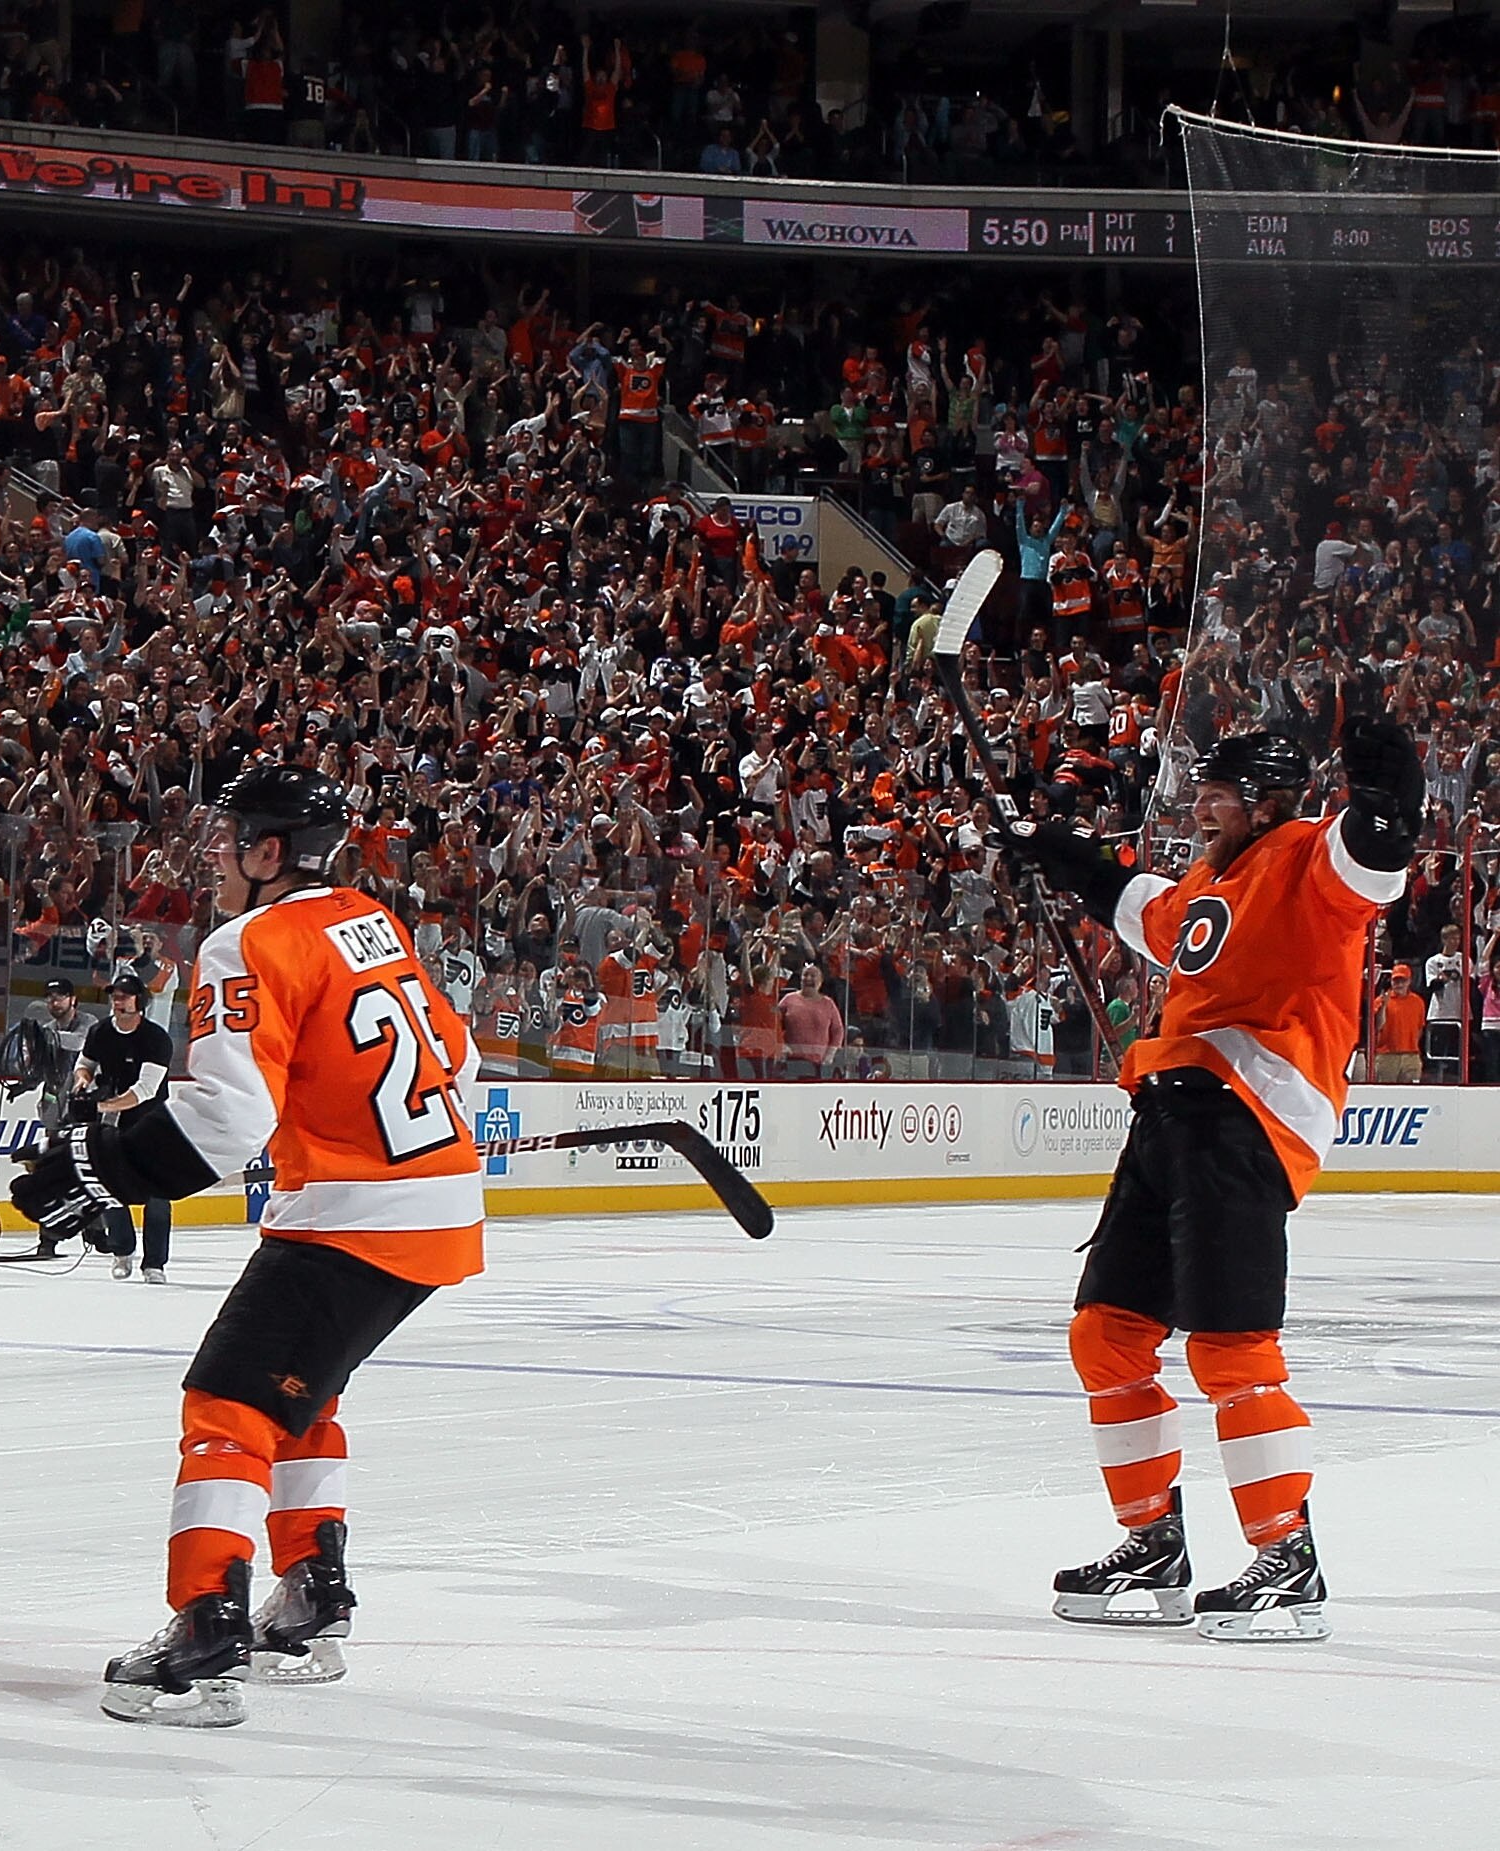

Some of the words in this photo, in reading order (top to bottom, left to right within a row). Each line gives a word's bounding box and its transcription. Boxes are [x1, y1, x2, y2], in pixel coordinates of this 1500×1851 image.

[244, 170, 362, 212] In!
[763, 219, 918, 246] WACHOVIA
[982, 217, 1048, 246] 5:50
[1060, 224, 1088, 241] PM
[1105, 214, 1136, 231] PIT
[1165, 214, 1176, 231] 3
[1247, 215, 1288, 233] EDM
[1429, 219, 1471, 236] BOS
[1105, 236, 1135, 253] NYI
[1165, 236, 1174, 254] 1
[1246, 238, 1287, 256] ANA
[1332, 229, 1370, 246] 8:00
[1426, 241, 1473, 258] WAS
[731, 504, 802, 526] EICO
[338, 917, 402, 965] CARLE
[188, 973, 260, 1043] 25
[575, 1089, 614, 1115] Always
[617, 1094, 625, 1111] a
[627, 1089, 644, 1115] big
[819, 1099, 894, 1150] xfinity
[1042, 1100, 1133, 1130] revolutionc
[1332, 1107, 1430, 1146] SSIVE
[1043, 1135, 1058, 1152] You
[1060, 1137, 1073, 1156] get
[1075, 1140, 1081, 1151] a
[1083, 1137, 1104, 1156] great
